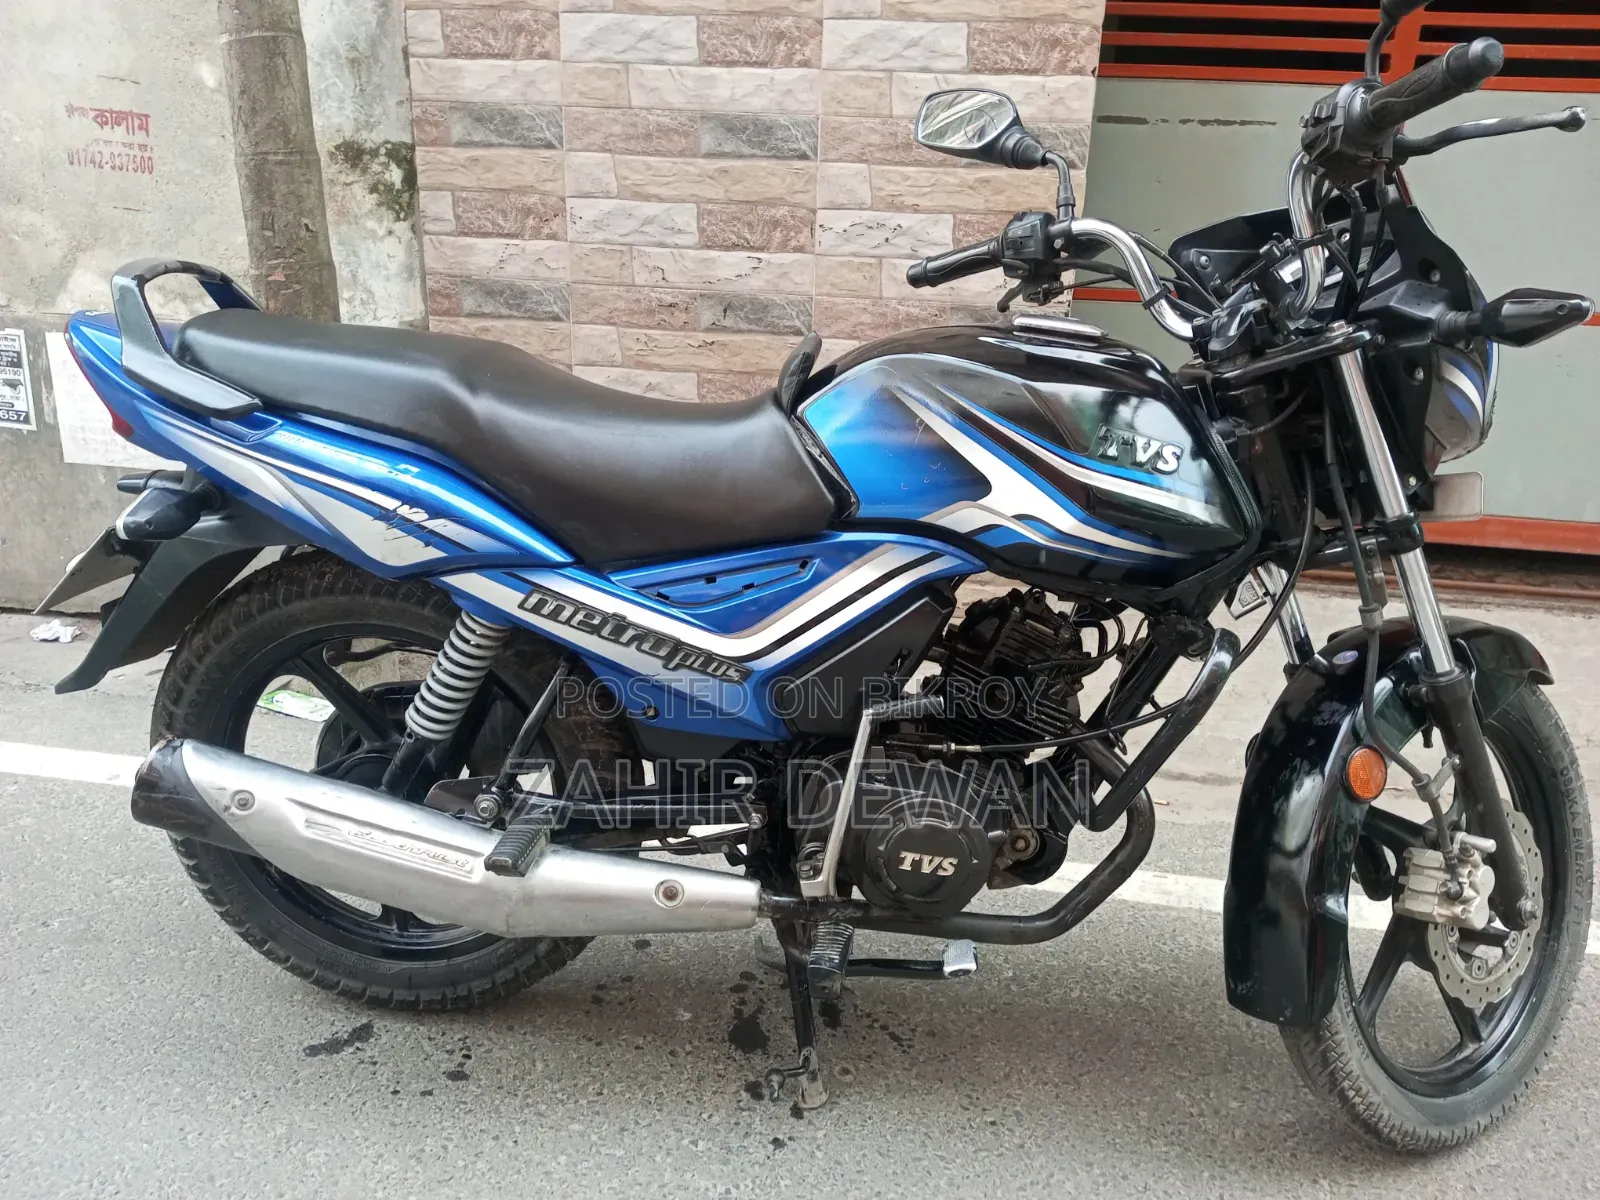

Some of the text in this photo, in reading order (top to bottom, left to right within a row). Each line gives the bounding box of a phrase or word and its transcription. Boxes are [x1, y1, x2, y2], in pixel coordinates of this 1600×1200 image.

[89, 106, 151, 137] কালাম
[1098, 424, 1184, 475] TVS
[898, 850, 959, 876] TVS
